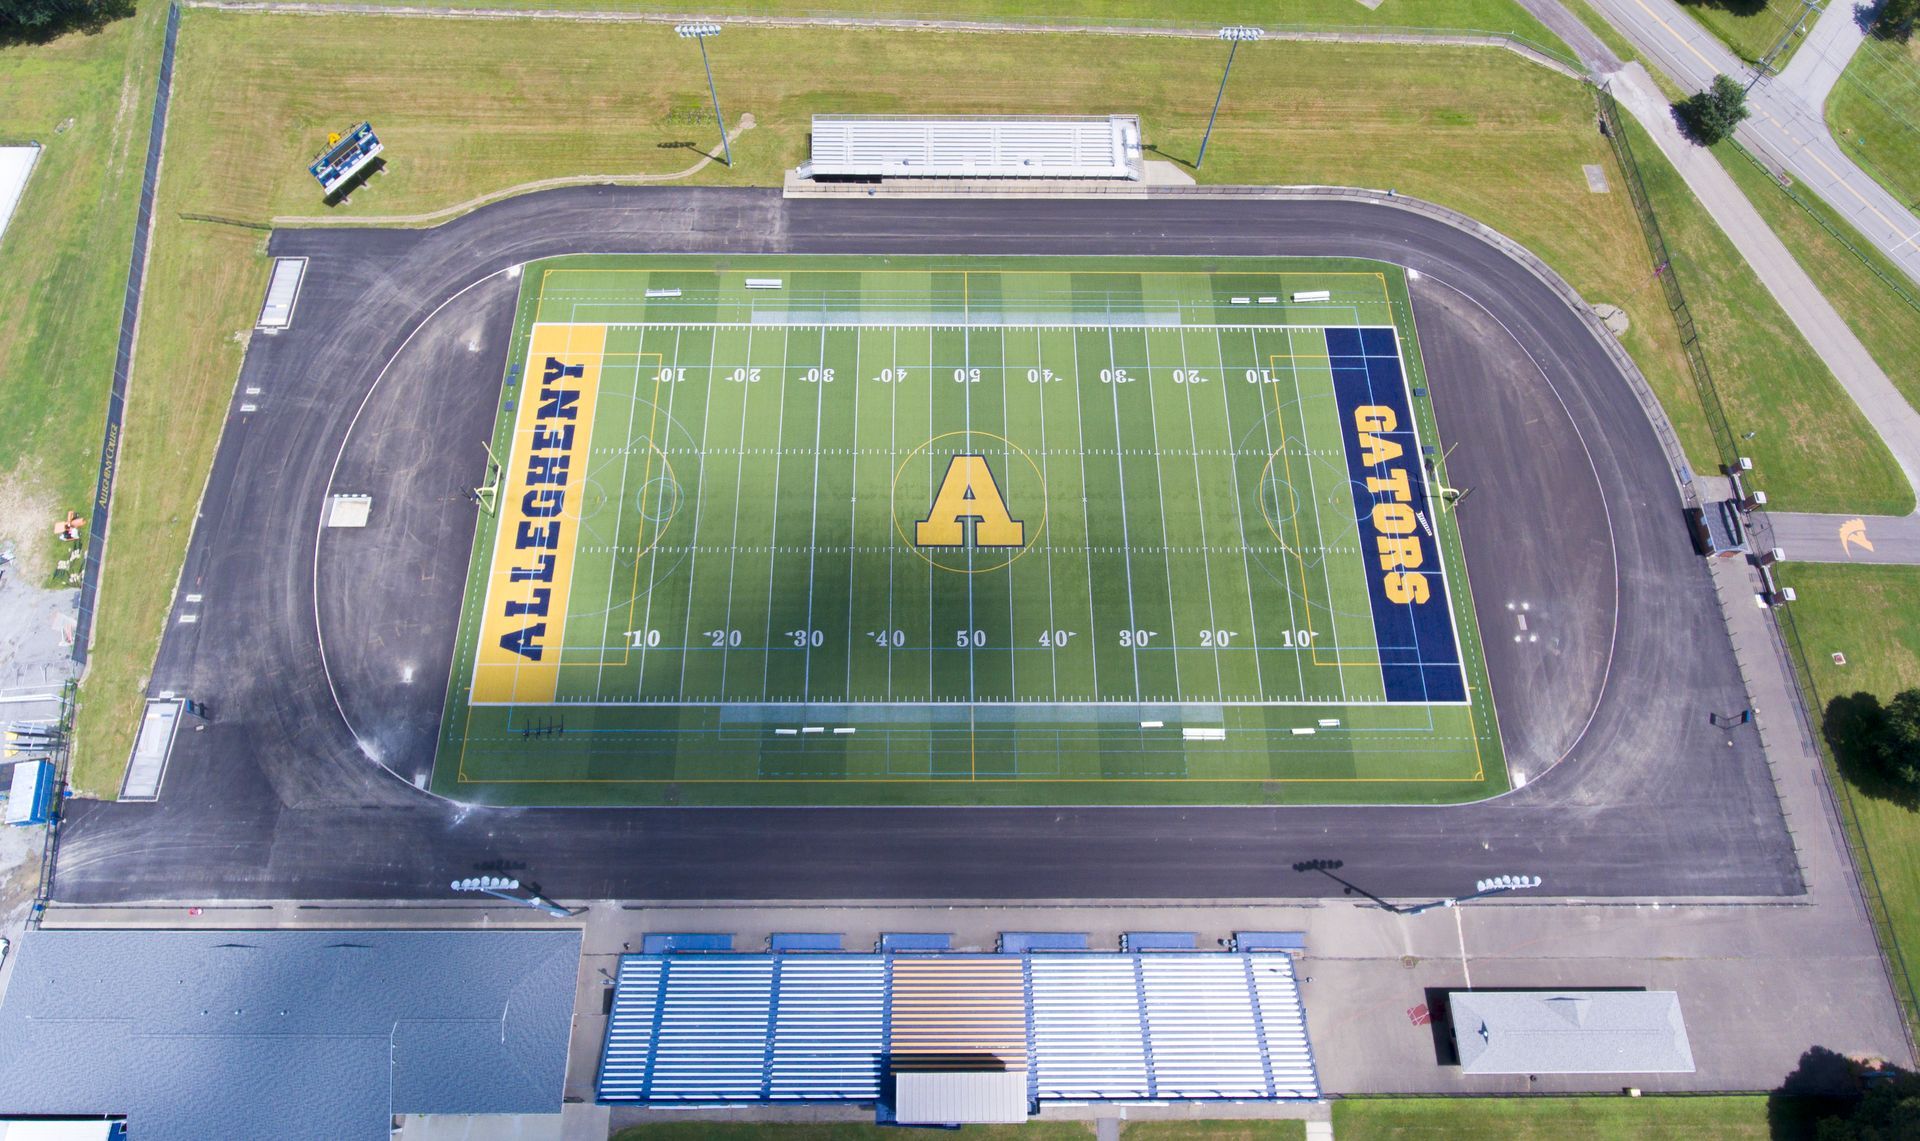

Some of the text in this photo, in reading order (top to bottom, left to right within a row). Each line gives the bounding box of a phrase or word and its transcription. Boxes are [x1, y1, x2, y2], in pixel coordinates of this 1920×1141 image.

[660, 368, 687, 382] 10
[734, 368, 761, 382] 20
[807, 368, 835, 382] 30
[881, 368, 908, 382] 40
[954, 368, 981, 383] 50
[1027, 368, 1054, 383] 40
[1100, 368, 1127, 383] 30
[1173, 369, 1201, 384] 20
[1246, 369, 1272, 384] 10
[499, 357, 584, 661] ALLEGHENY
[915, 454, 1025, 547] A
[1355, 405, 1430, 604] GATORS
[631, 629, 661, 647] 10
[711, 629, 742, 647] 20
[793, 629, 824, 647] 30
[875, 629, 905, 647] 40
[956, 629, 986, 647] 50
[1038, 629, 1068, 647] 40
[1119, 629, 1149, 647] 30
[1200, 629, 1229, 647] 20
[1282, 629, 1311, 647] 10
